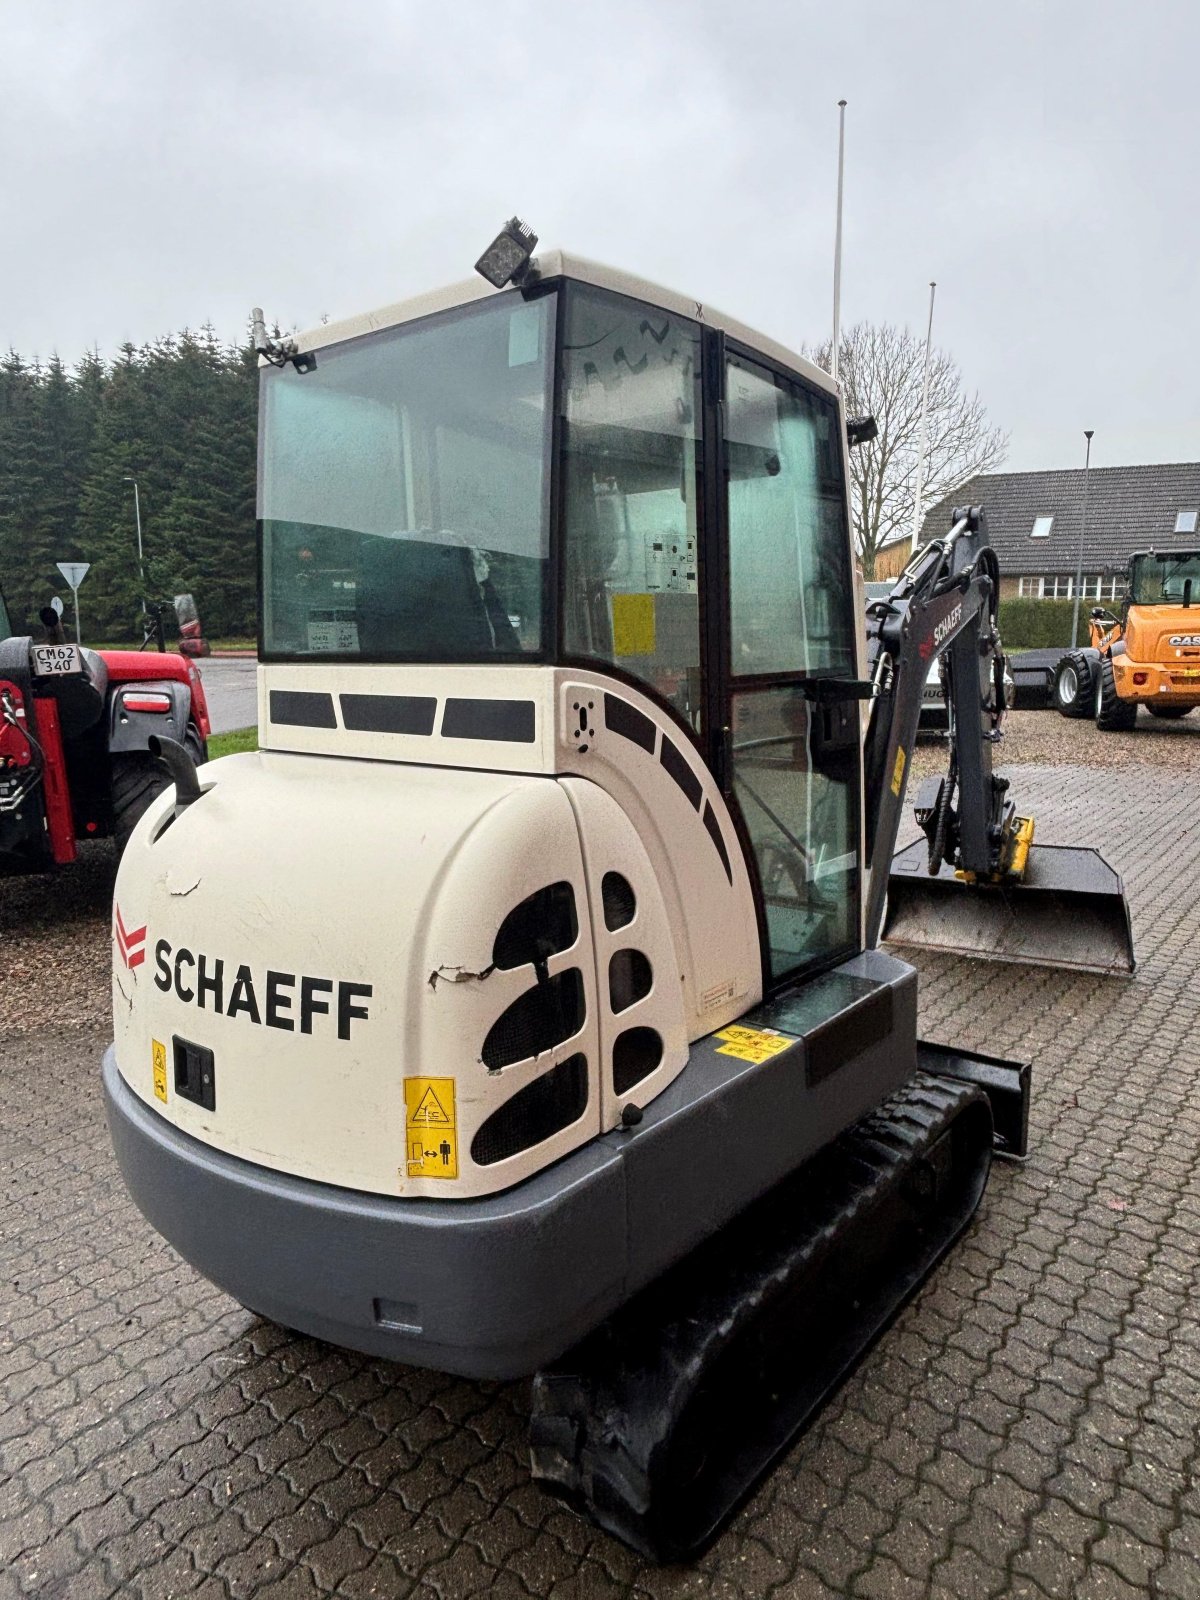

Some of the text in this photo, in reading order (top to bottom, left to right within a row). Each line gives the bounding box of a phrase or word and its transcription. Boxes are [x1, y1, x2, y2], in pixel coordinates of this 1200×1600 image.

[934, 602, 962, 646] SCHAEFF
[36, 647, 75, 661] CM62
[44, 660, 73, 673] 340
[153, 938, 373, 1041] SCHAEFF
